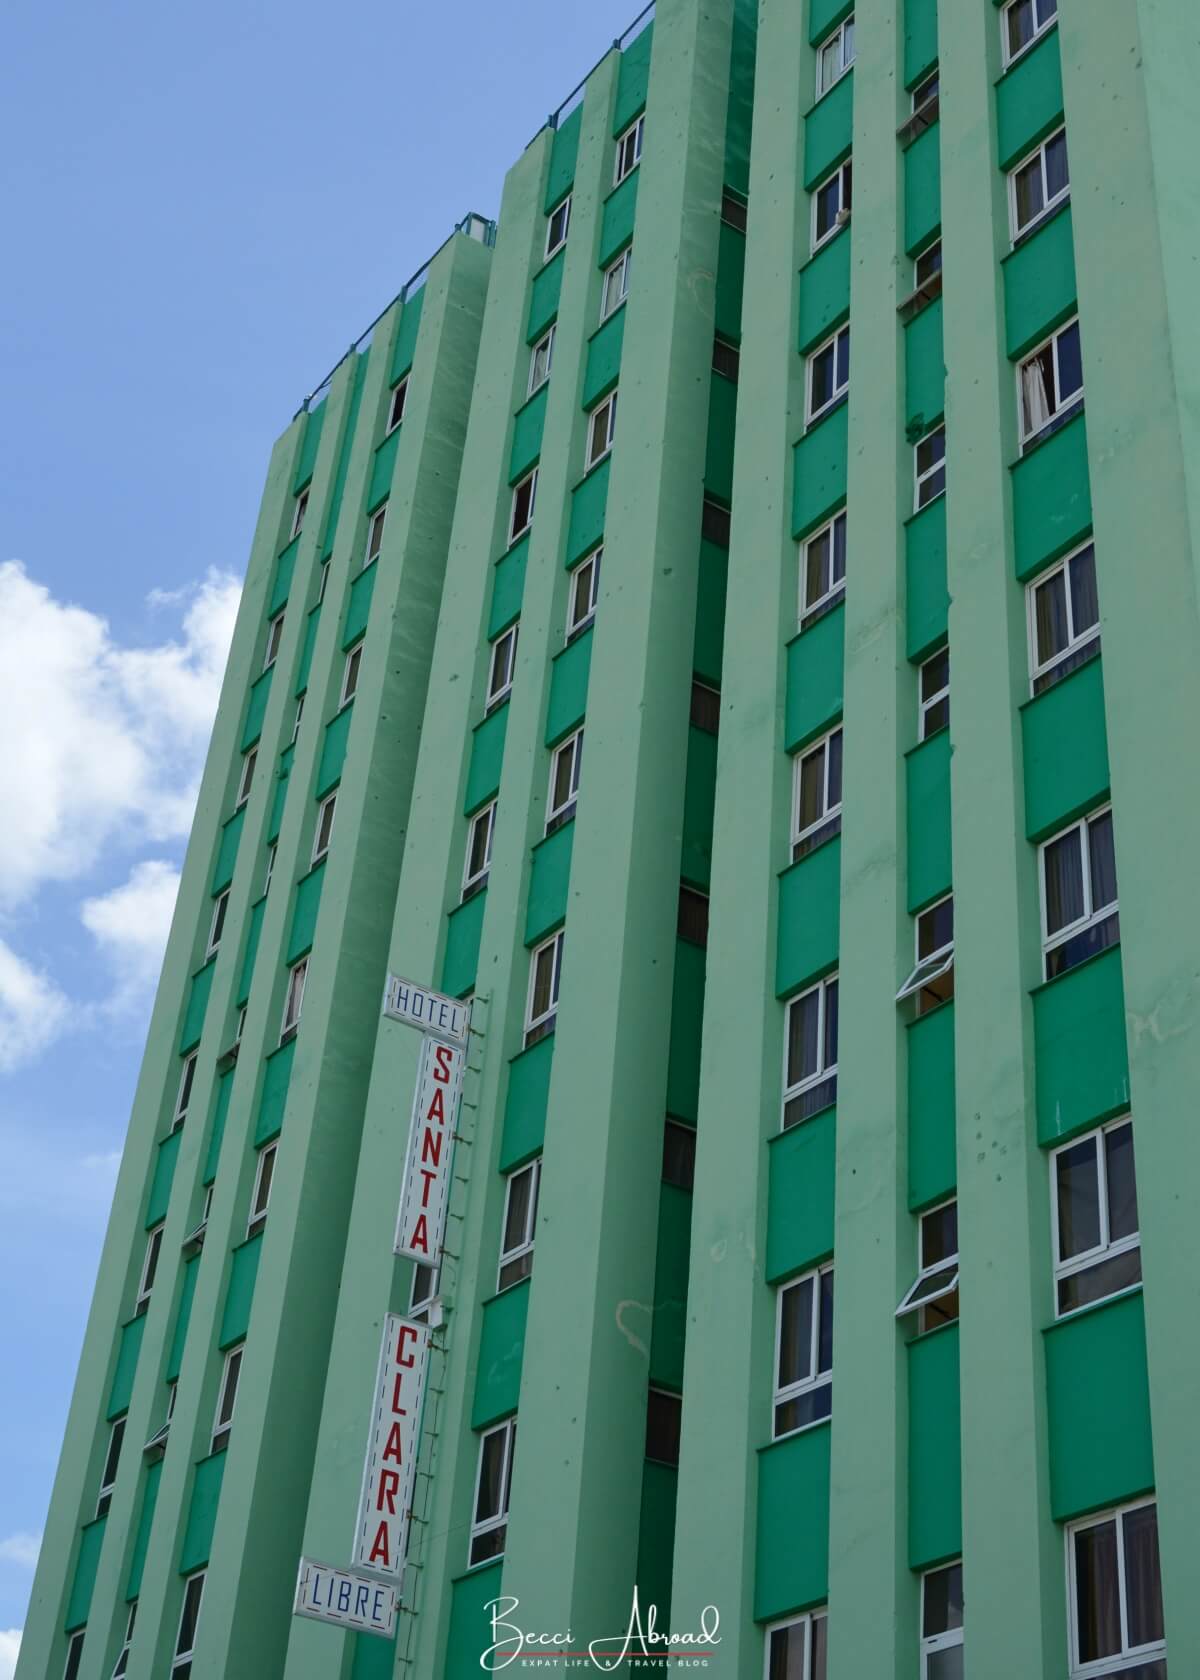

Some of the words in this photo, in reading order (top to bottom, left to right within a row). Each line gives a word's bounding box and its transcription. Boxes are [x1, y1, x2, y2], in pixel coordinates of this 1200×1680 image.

[396, 988, 459, 1033] HOTEL
[409, 1045, 453, 1254] SANTA
[368, 1325, 418, 1566] CLARA
[312, 1573, 386, 1621] LIBRE
